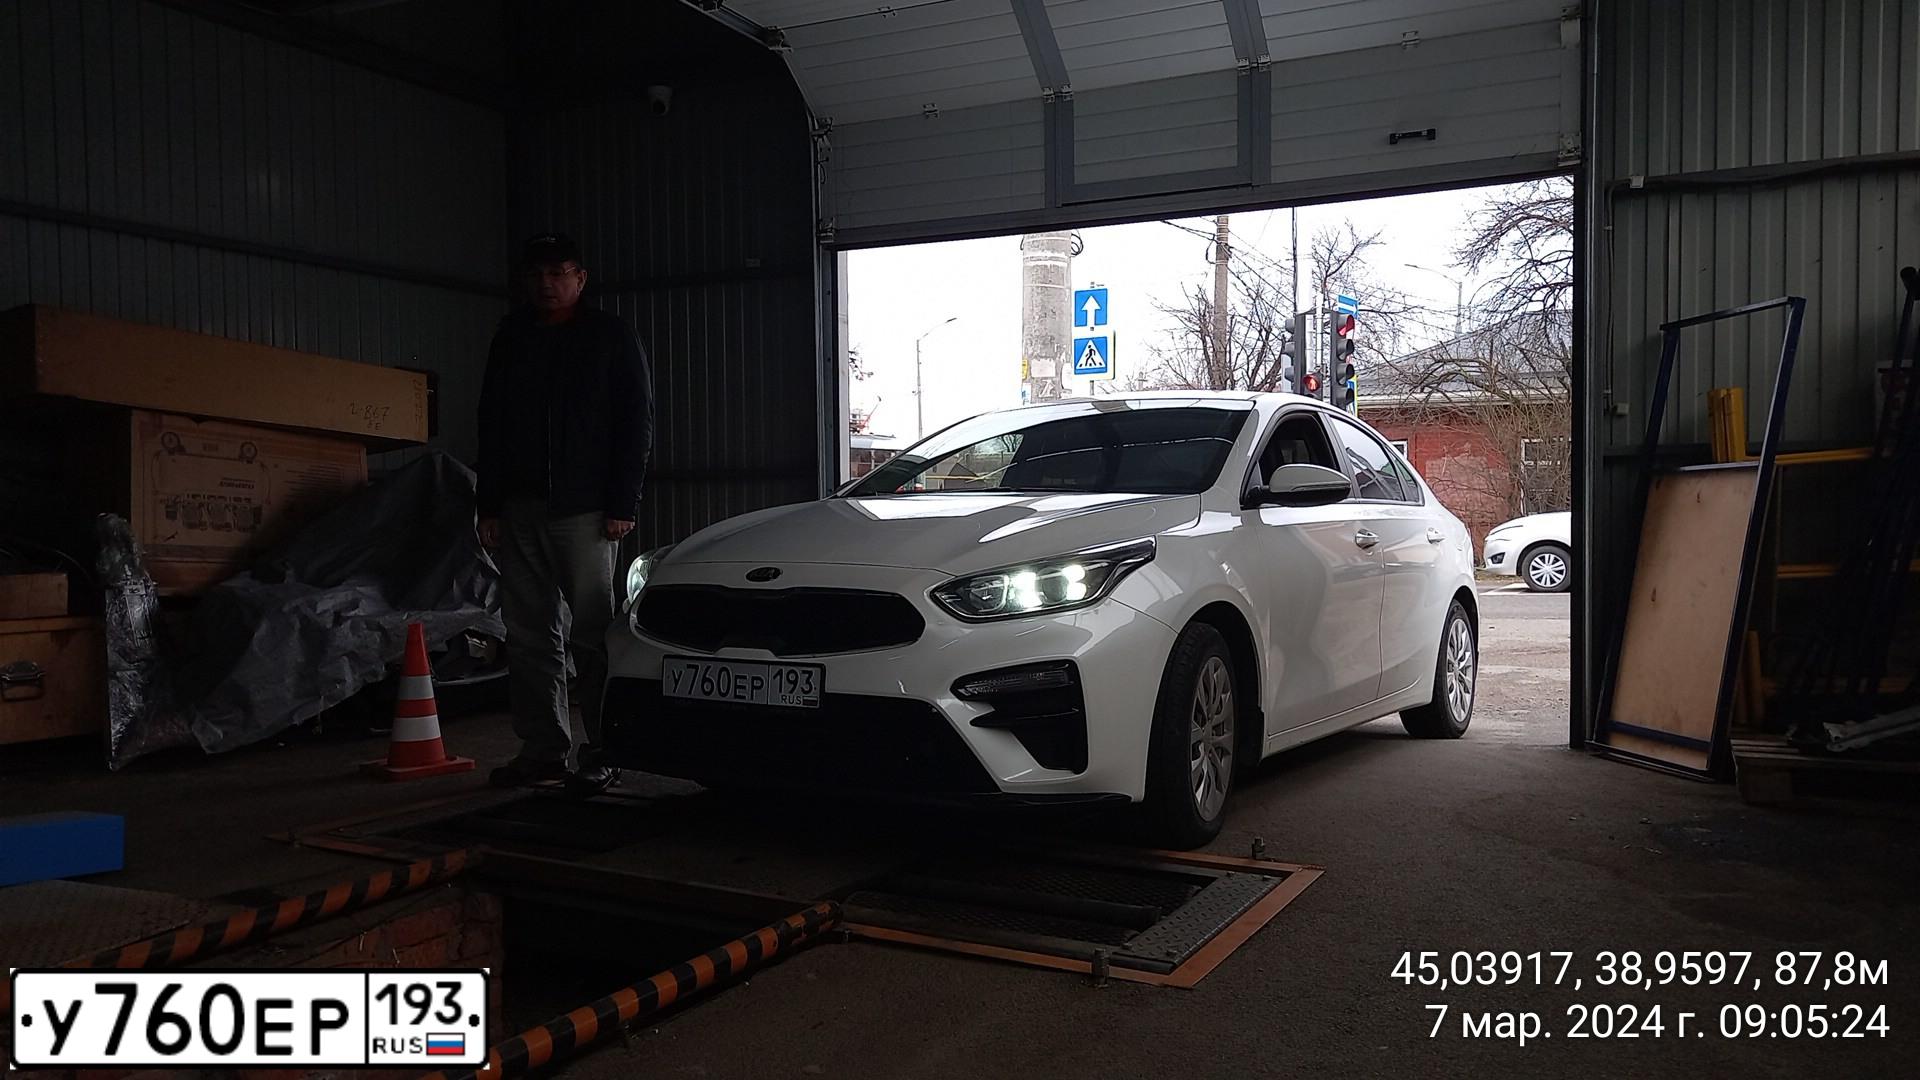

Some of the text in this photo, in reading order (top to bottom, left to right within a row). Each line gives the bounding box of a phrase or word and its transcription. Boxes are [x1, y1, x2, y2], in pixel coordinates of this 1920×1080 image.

[672, 664, 764, 700] У760ЕР
[773, 668, 813, 694] 193
[781, 695, 802, 705] RUS
